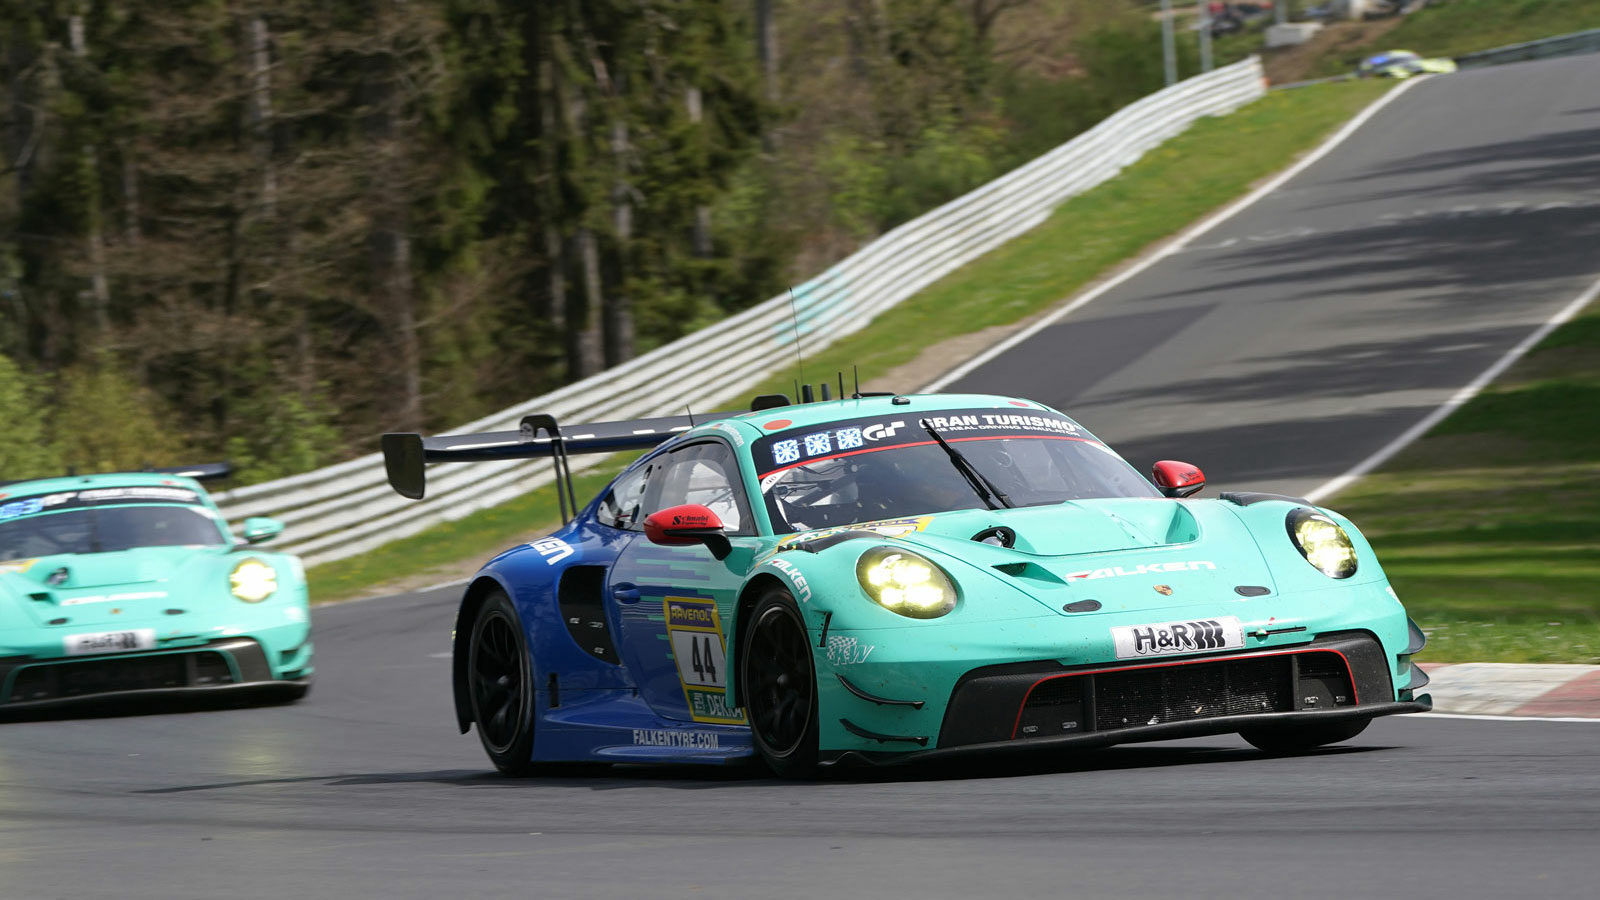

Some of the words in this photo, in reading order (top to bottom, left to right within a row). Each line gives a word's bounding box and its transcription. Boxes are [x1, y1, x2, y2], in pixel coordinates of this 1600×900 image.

[918, 415, 979, 429] GRAN
[982, 415, 1076, 432] TURISMO
[1064, 560, 1217, 583] FALKEN
[670, 607, 712, 622] RAVENOL
[1133, 623, 1196, 652] H&R
[692, 635, 717, 683] 44
[632, 729, 720, 749] FALKENTYRE.COM
